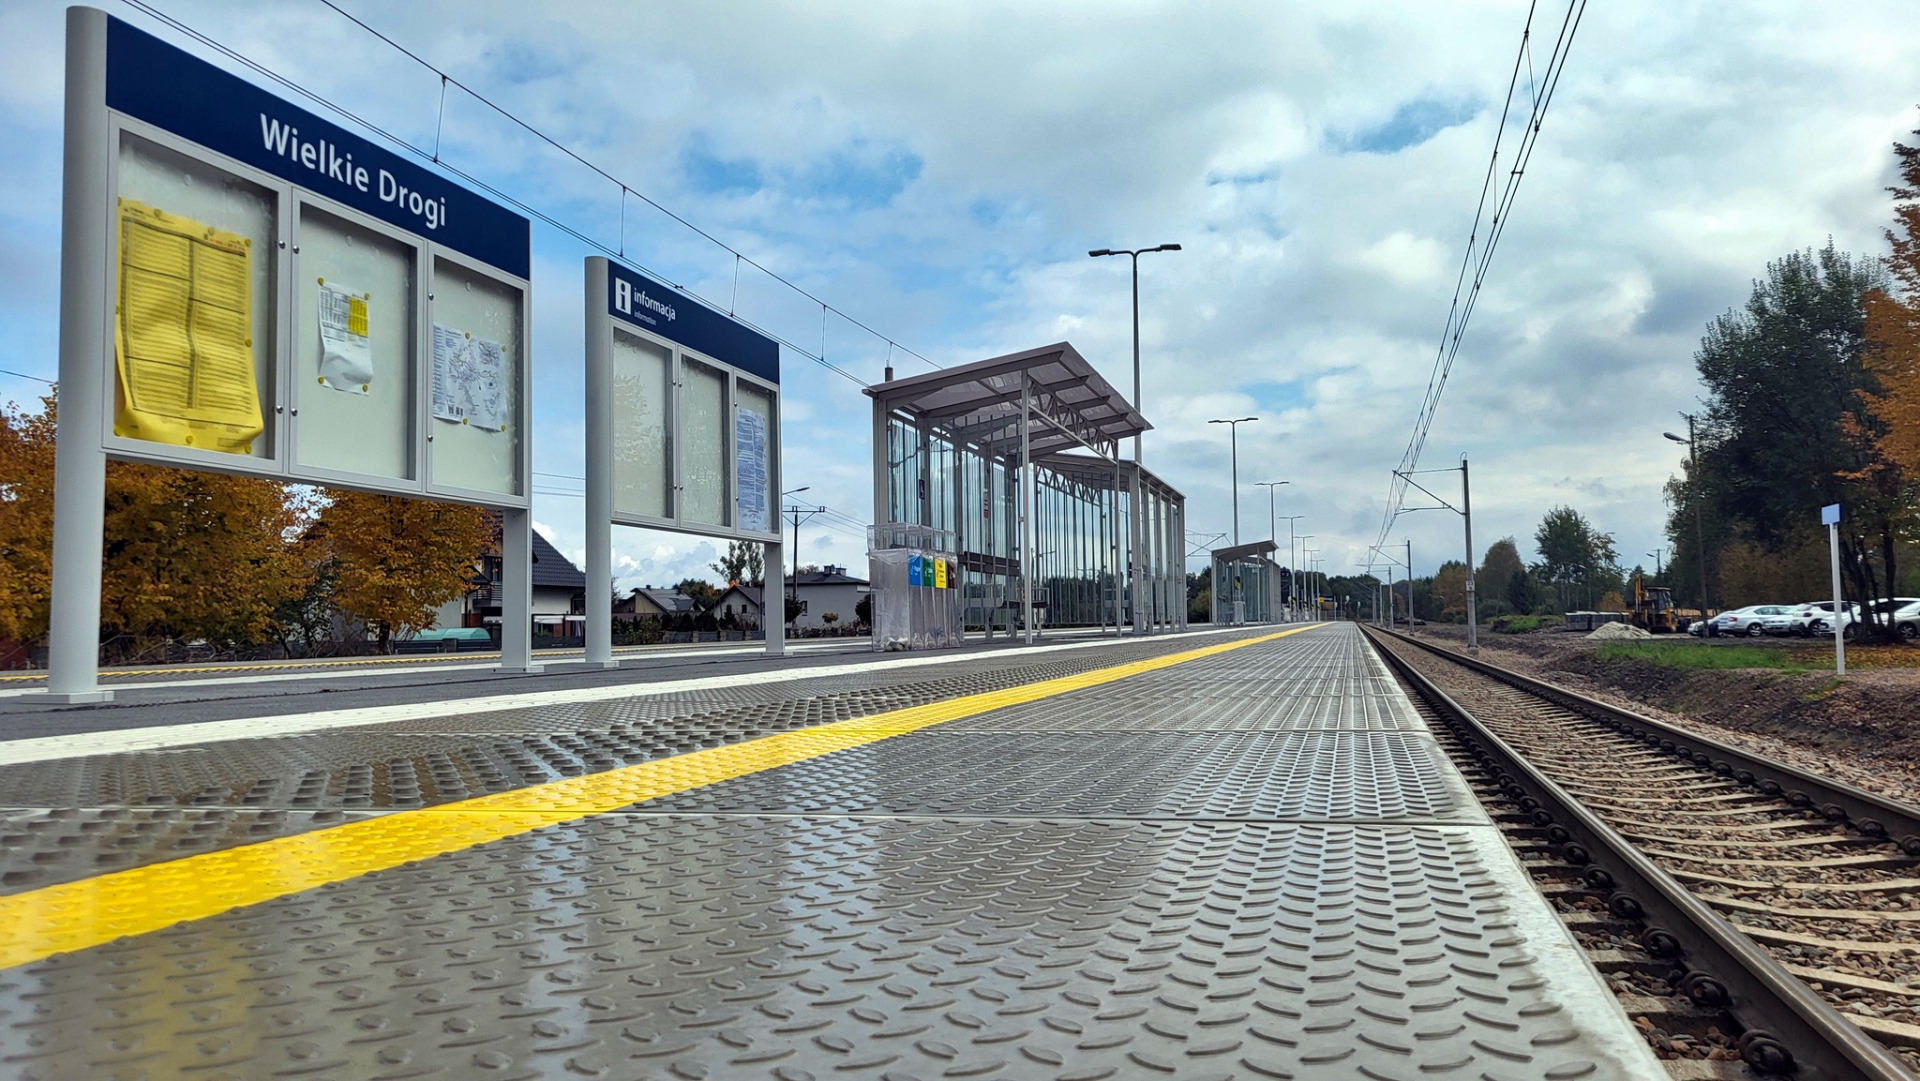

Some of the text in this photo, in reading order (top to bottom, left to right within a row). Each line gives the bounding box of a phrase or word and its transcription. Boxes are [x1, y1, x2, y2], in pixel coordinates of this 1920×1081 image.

[260, 112, 445, 229] Wielkie Drogi
[634, 287, 676, 321] informacja
[634, 310, 657, 325] information
